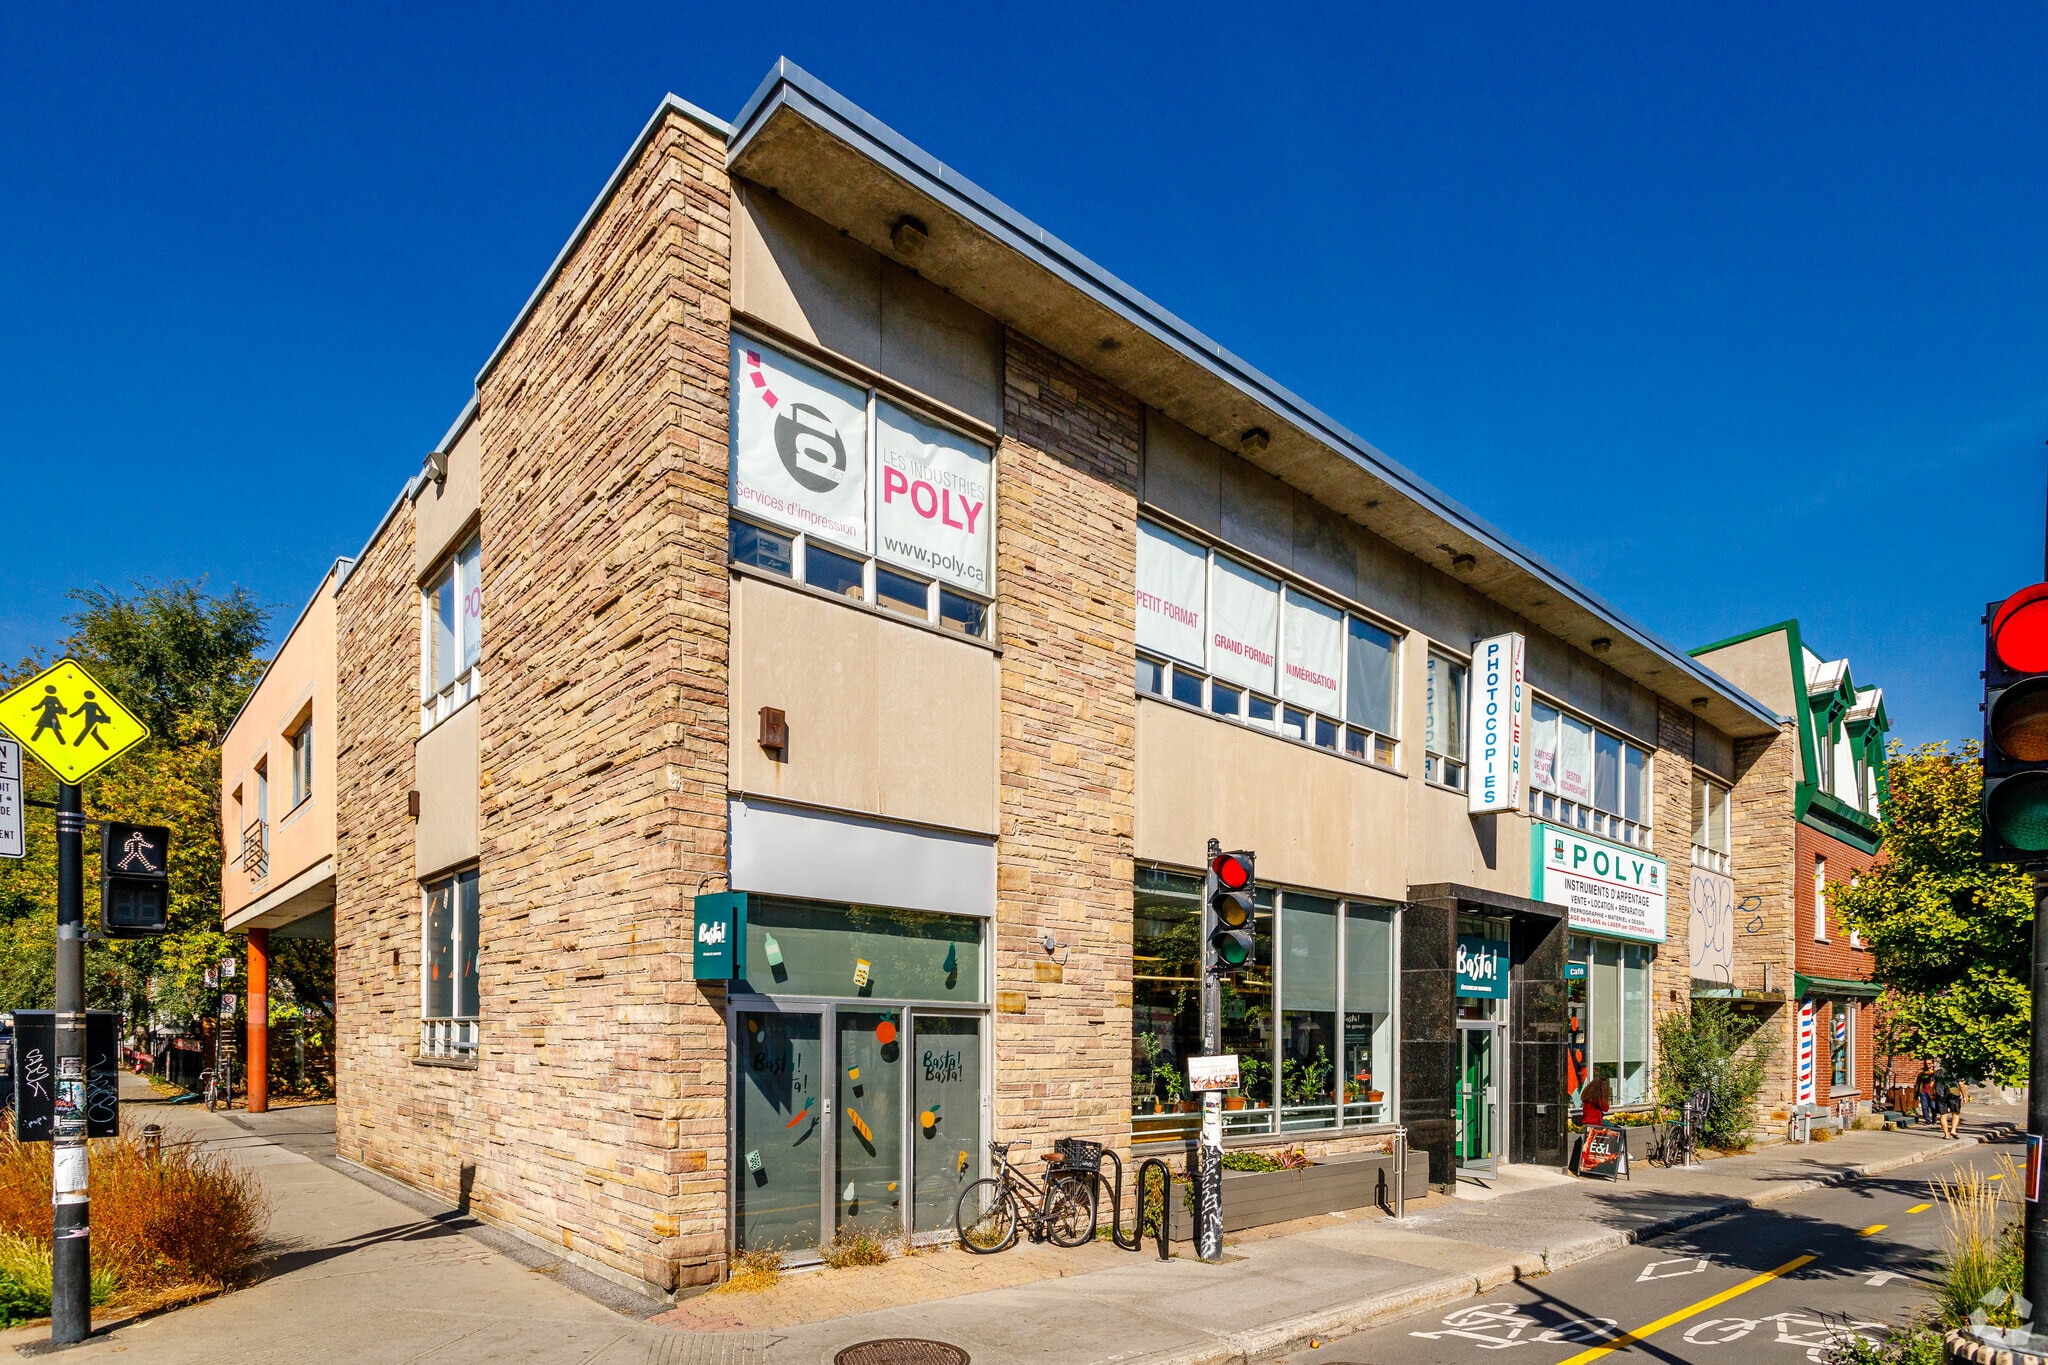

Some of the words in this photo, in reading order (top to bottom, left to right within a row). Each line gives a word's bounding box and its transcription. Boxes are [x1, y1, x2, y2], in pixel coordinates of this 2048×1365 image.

[883, 447, 906, 471] LES
[910, 460, 985, 501] INDUSTRIES
[735, 480, 784, 511] Services
[787, 502, 857, 536] d'impression
[884, 465, 984, 534] POLY
[884, 536, 984, 582] www.poly.ca
[1136, 589, 1161, 613] PETIT
[1163, 601, 1199, 628] FORMAT
[1214, 633, 1243, 656] GRAND
[1244, 645, 1274, 668] FORMAT
[1285, 662, 1337, 692] NUMÉRISATION
[1484, 643, 1499, 804] PHOTOCOPIES
[1512, 669, 1522, 775] COULEUR
[1573, 844, 1645, 885] POLY
[1564, 878, 1610, 899] INSTRUMENTS
[1611, 888, 1650, 907] D'ARPENTAGE
[1571, 894, 1587, 906] VENTE
[1591, 899, 1615, 912] LOCATION
[698, 920, 727, 946] Basta!
[1570, 907, 1604, 919] REPROGRAPHIE
[1631, 918, 1645, 926] DESSIN
[1586, 917, 1601, 926] PLANS
[1607, 920, 1621, 928] LASER
[1456, 943, 1497, 981] Basta!
[1570, 967, 1584, 976] Café
[923, 1049, 961, 1070] Basta!
